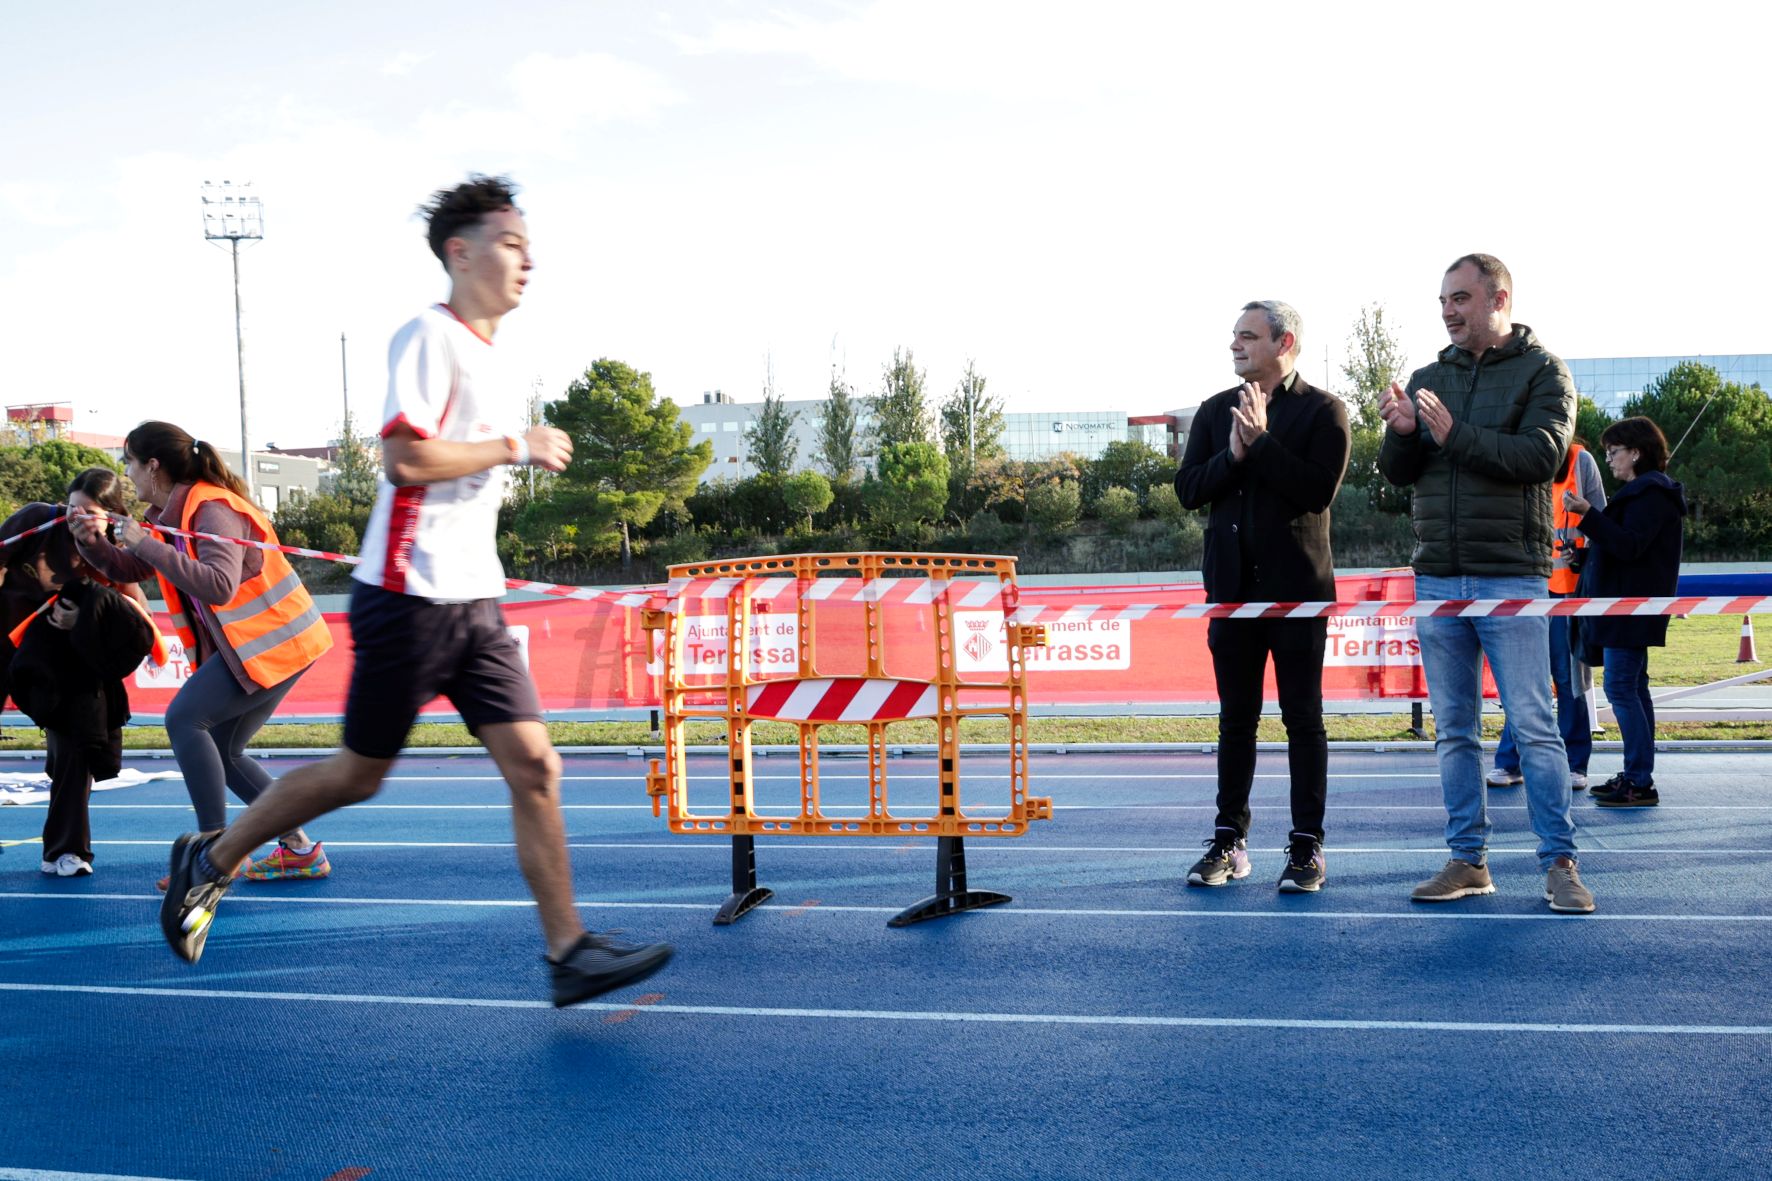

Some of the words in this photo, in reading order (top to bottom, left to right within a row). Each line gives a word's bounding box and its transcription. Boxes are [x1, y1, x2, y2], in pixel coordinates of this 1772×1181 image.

[1065, 423, 1116, 431] NOVOMATIC
[776, 622, 794, 636] de
[1100, 619, 1120, 632] de
[1327, 615, 1416, 630] Ajuntamen
[1326, 633, 1420, 657] Terras
[687, 644, 796, 664] Terssa
